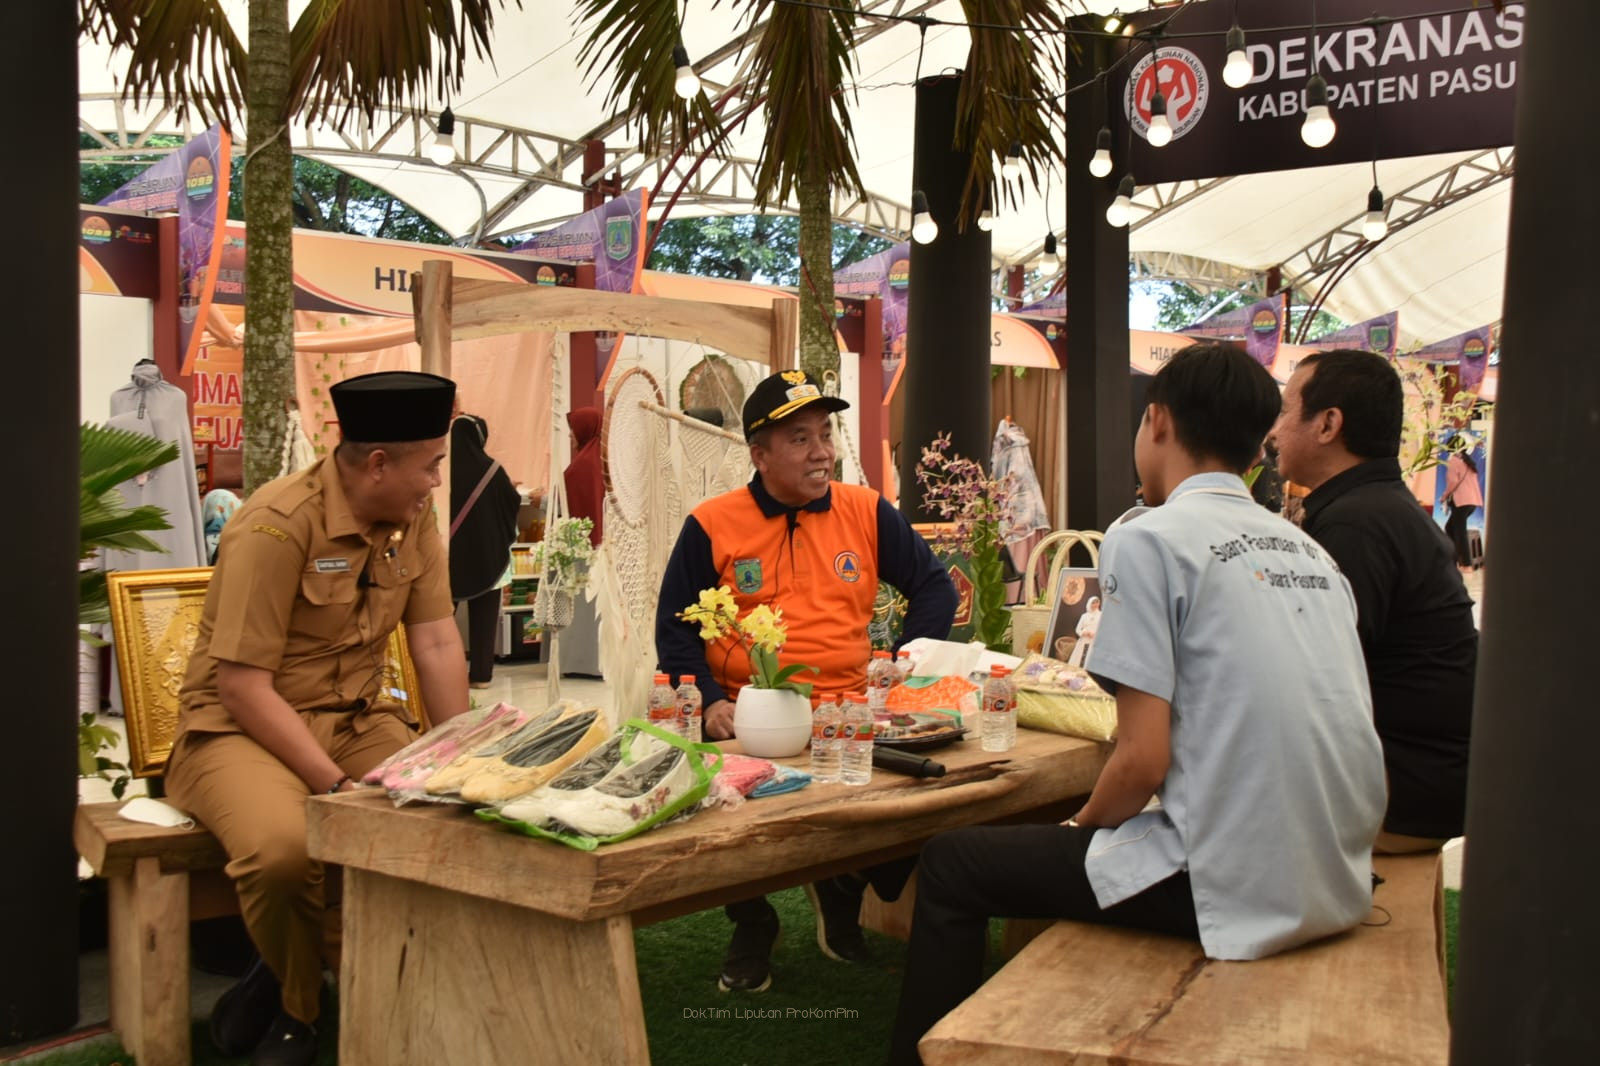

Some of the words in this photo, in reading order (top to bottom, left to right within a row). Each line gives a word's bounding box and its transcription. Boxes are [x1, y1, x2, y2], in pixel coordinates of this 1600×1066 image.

[1430, 61, 1517, 97] PASU
[375, 266, 415, 292] HI
[1210, 537, 1247, 563] Suara
[1241, 533, 1299, 554] Pasuruan
